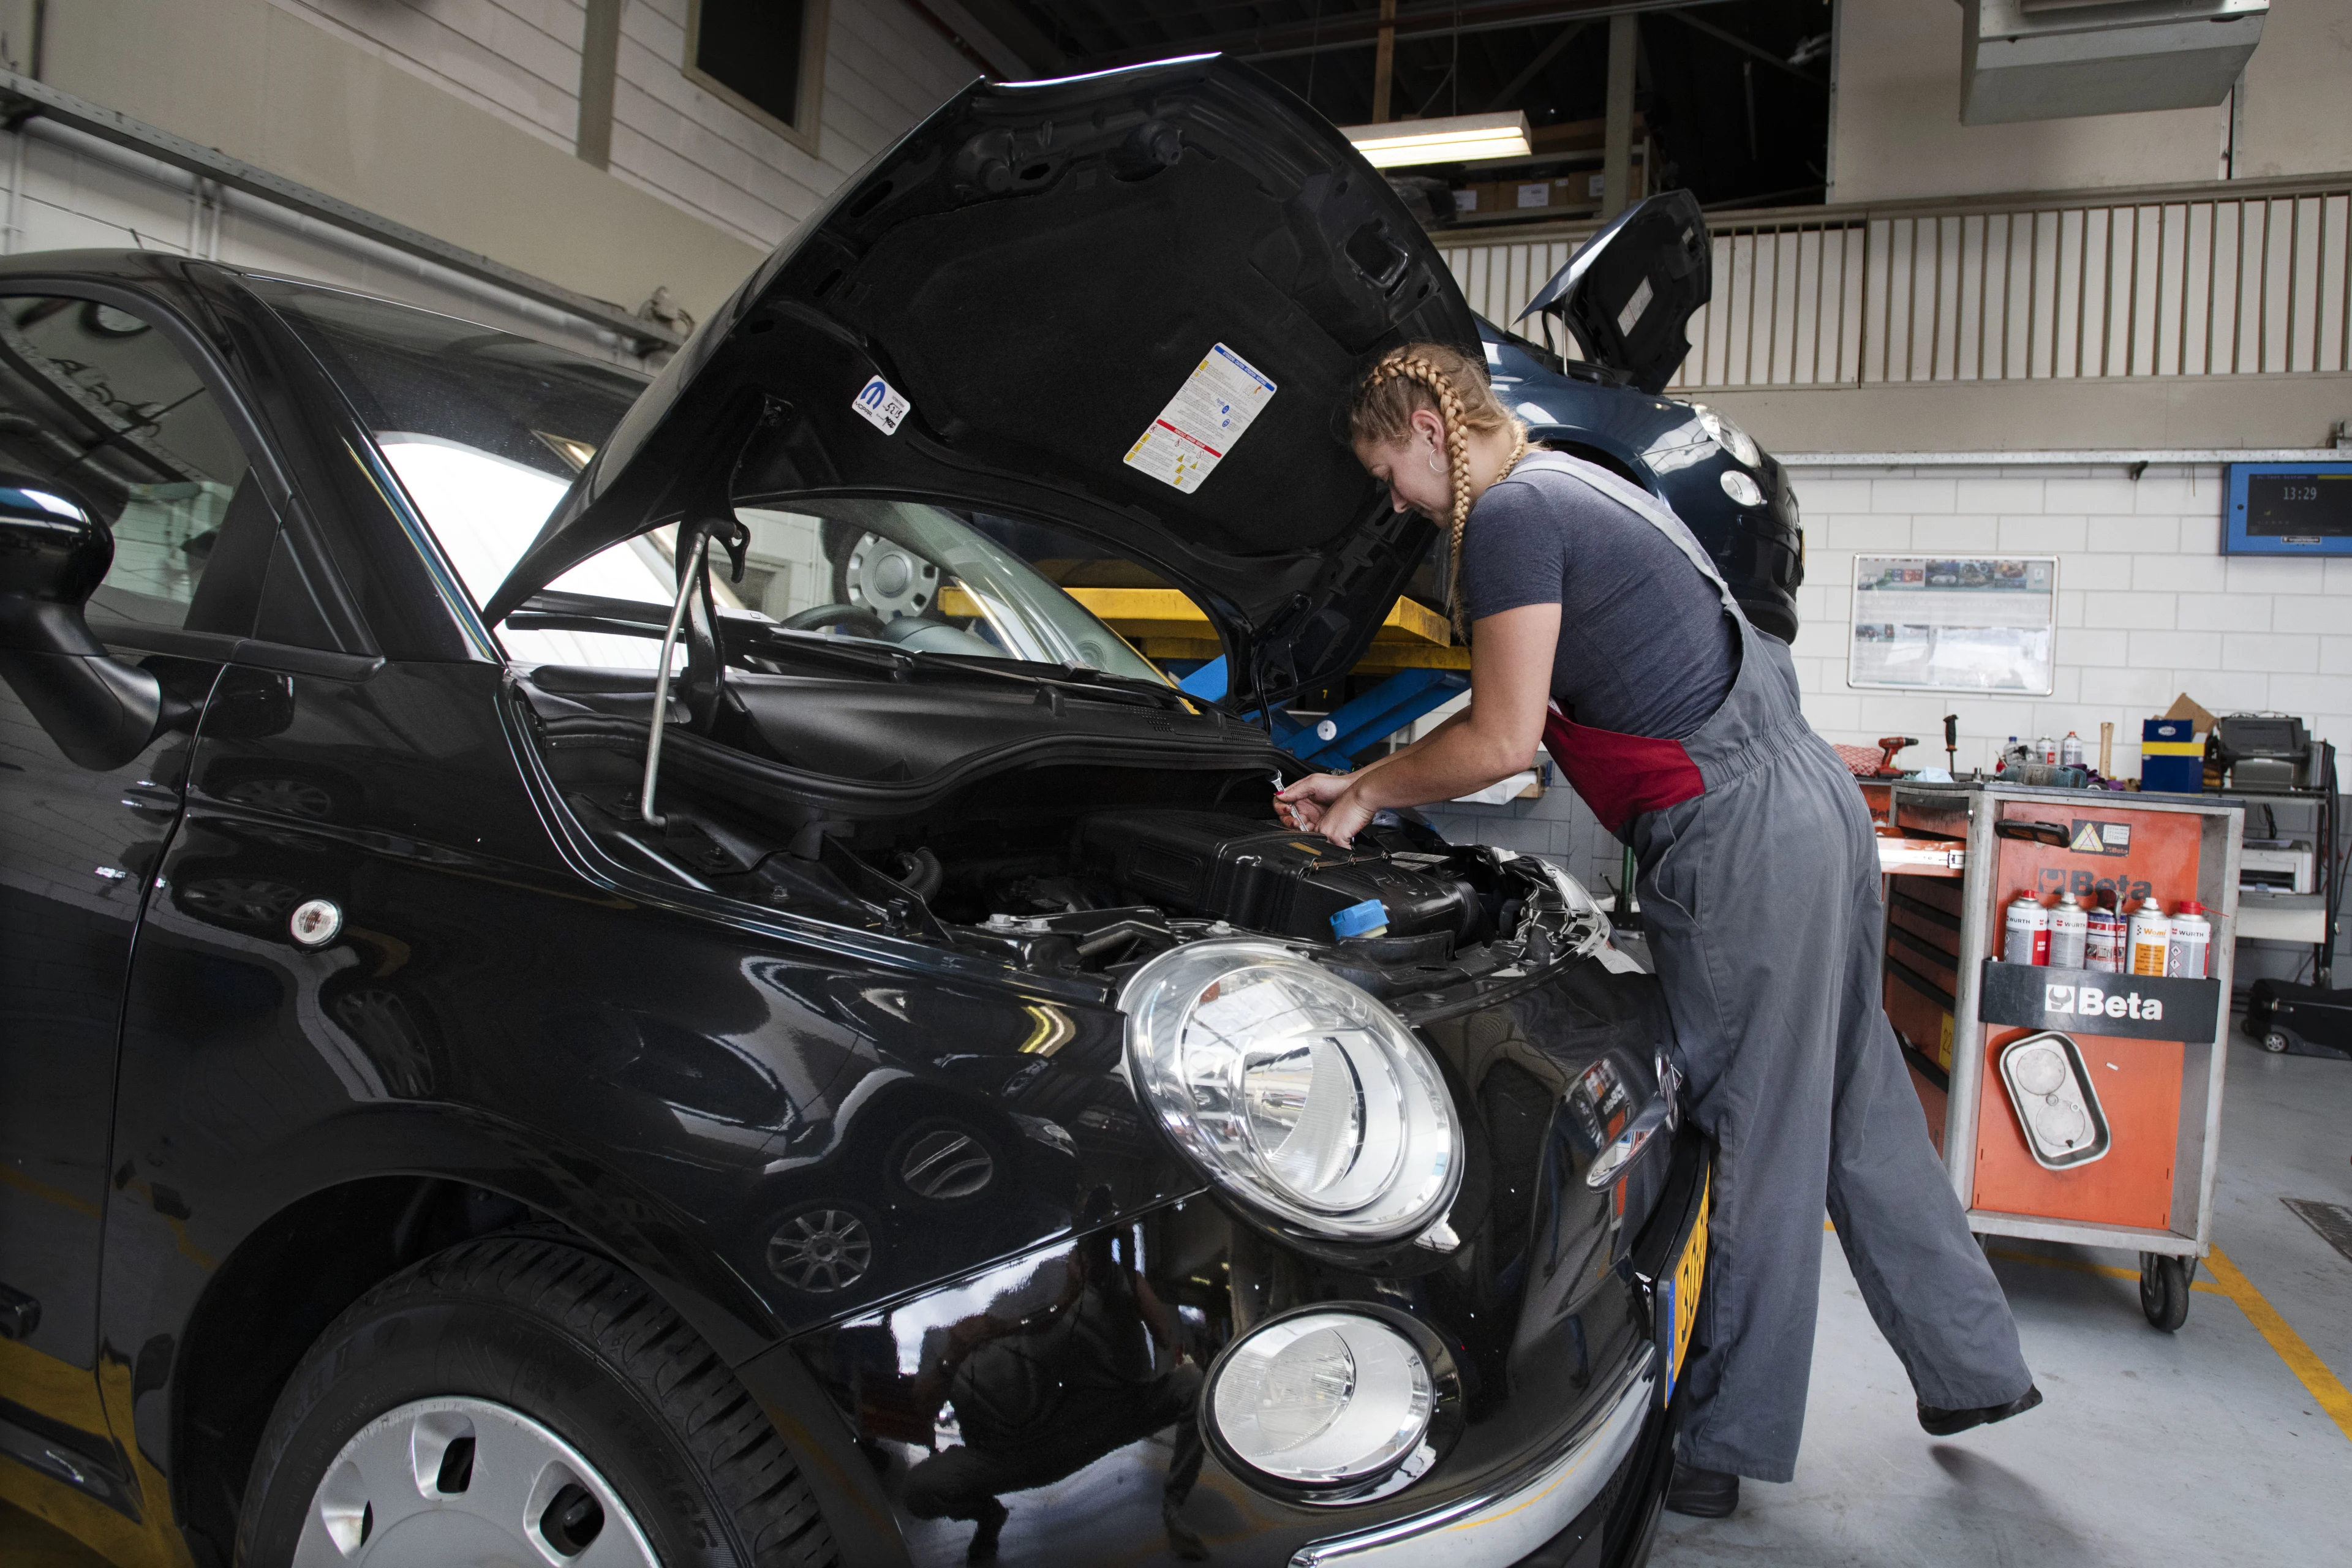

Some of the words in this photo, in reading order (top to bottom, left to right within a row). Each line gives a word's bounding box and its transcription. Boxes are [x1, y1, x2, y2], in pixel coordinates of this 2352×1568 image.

[854, 401, 873, 417] MOPAR
[2283, 487, 2317, 500] 13:29
[2078, 987, 2162, 1020] Beta
